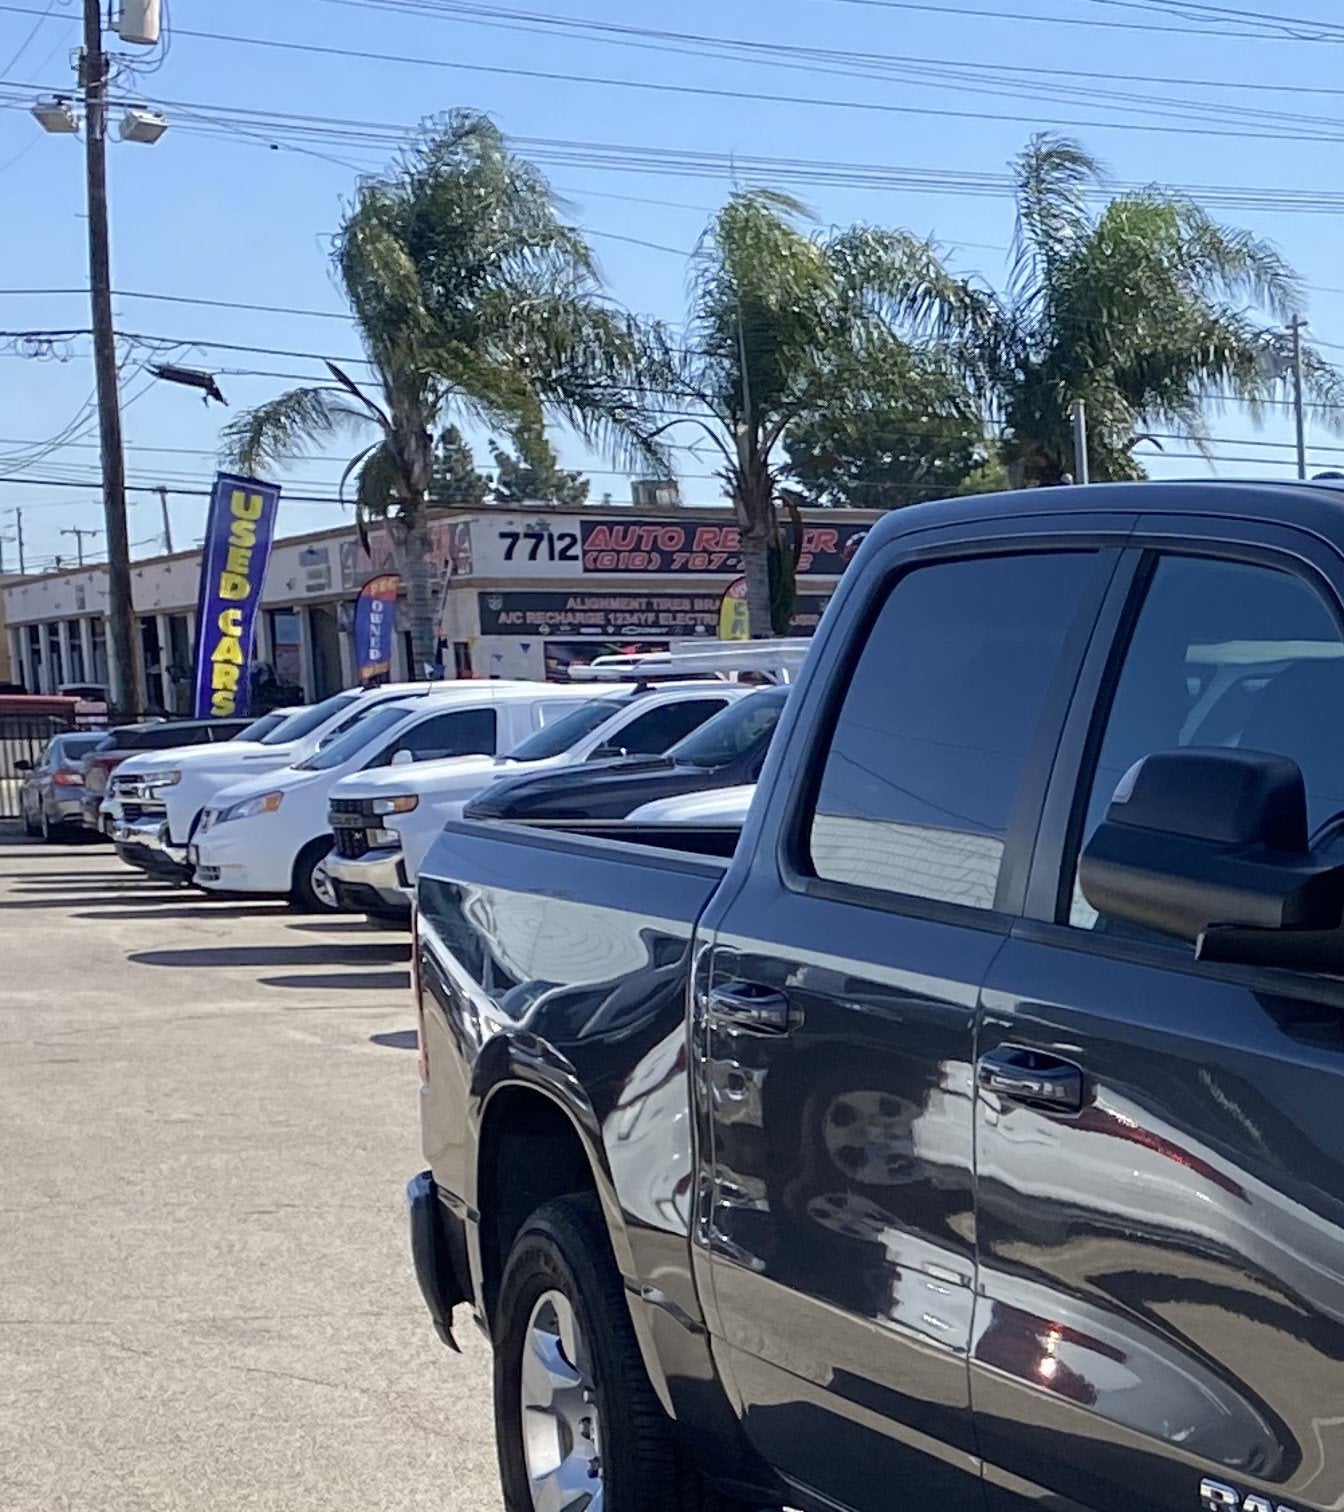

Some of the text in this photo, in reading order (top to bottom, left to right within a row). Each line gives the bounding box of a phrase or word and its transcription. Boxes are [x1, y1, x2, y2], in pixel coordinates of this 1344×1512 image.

[499, 531, 580, 562] 7712
[583, 525, 685, 551] AUTO
[210, 490, 263, 717] USED CARS
[526, 612, 605, 624] RECHARGE
[368, 600, 384, 661] OWNED
